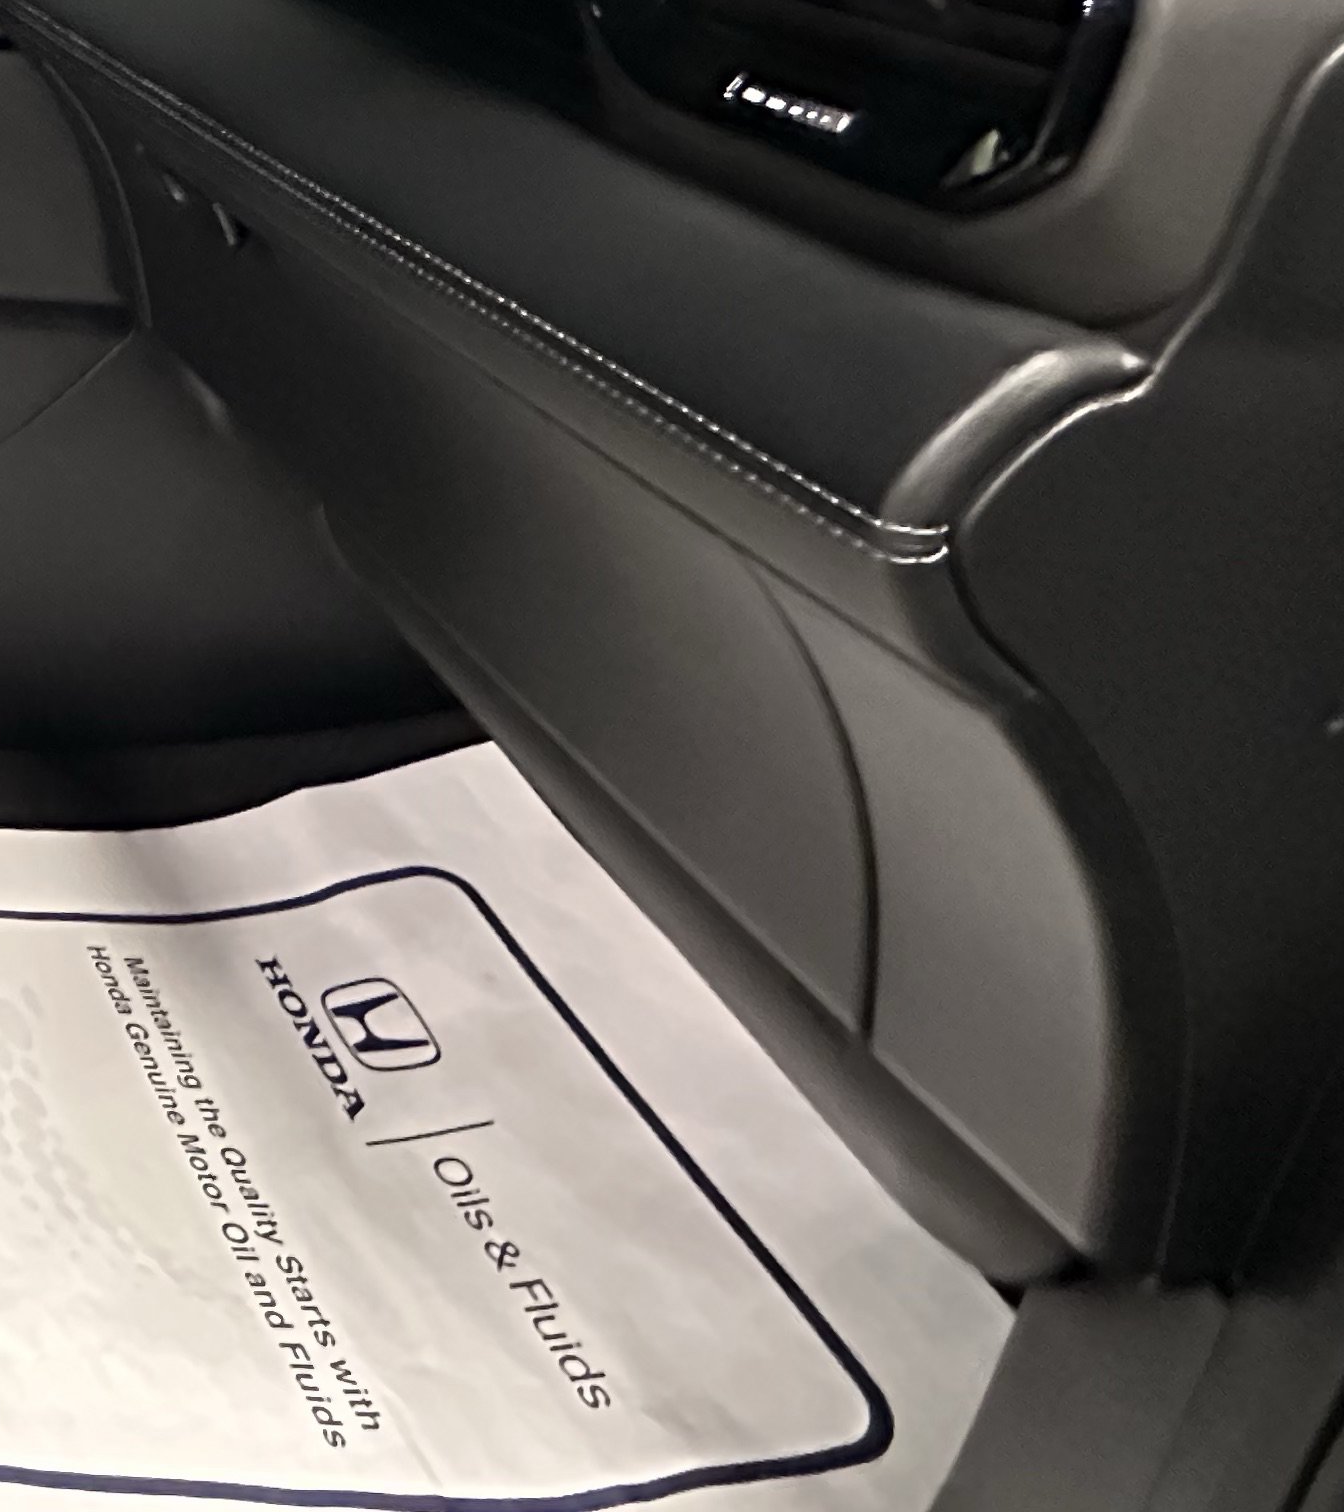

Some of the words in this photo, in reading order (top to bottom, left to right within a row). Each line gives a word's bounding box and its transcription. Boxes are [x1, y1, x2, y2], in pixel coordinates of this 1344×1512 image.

[86, 946, 132, 1015] Honda
[125, 1022, 185, 1126] Genuine
[176, 1134, 230, 1214] Motor
[221, 1222, 260, 1262] Oil
[244, 1272, 295, 1329] and
[278, 1342, 347, 1448] Fluids
[123, 957, 202, 1089] Maintaining
[194, 1098, 227, 1139] the
[220, 1147, 284, 1246] Quality
[275, 1255, 337, 1347] Starts
[329, 1359, 381, 1430] with
[254, 952, 365, 1123] HONDA
[433, 1156, 494, 1231] Oils
[483, 1240, 520, 1273] &
[509, 1278, 611, 1409] Fluids
